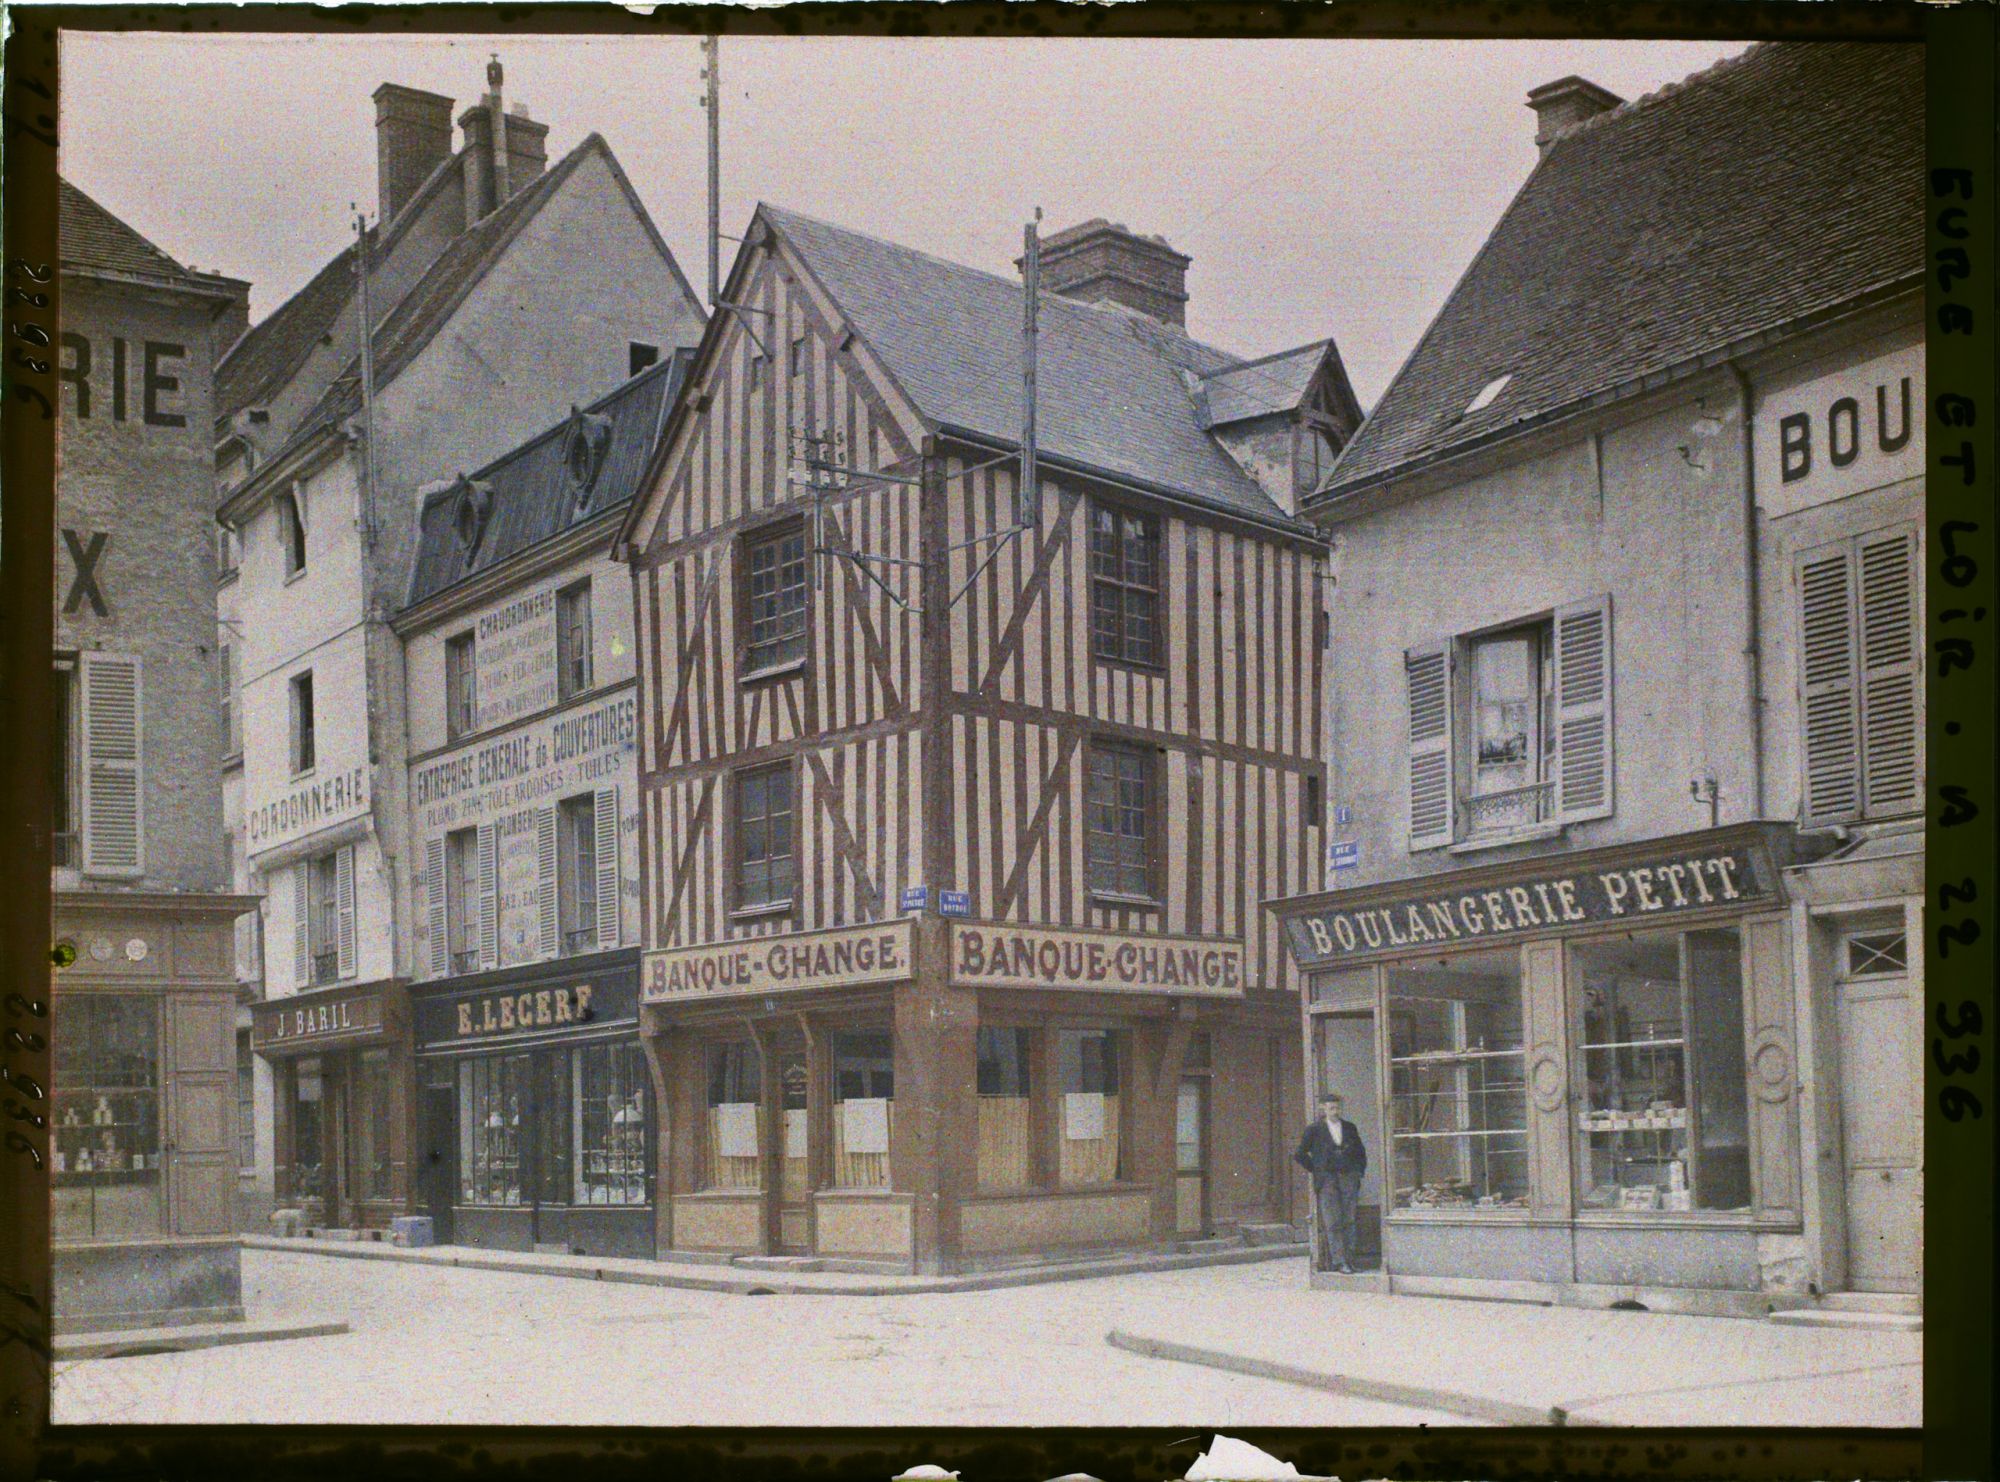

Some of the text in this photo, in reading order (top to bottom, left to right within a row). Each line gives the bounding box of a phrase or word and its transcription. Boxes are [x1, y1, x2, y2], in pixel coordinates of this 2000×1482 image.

[1931, 168, 1973, 335] EURE
[1780, 377, 1911, 484] BOU
[1935, 393, 1976, 486] ET
[418, 755, 474, 806] ENTREPRISE
[553, 699, 634, 764] COUVERTURES
[515, 769, 563, 802] ARDOISES
[577, 751, 621, 782] TUILES
[251, 768, 363, 840] CORDONNERIE
[1306, 856, 1740, 954] BOULANGERIE PETIT
[296, 1002, 351, 1035] BARIL
